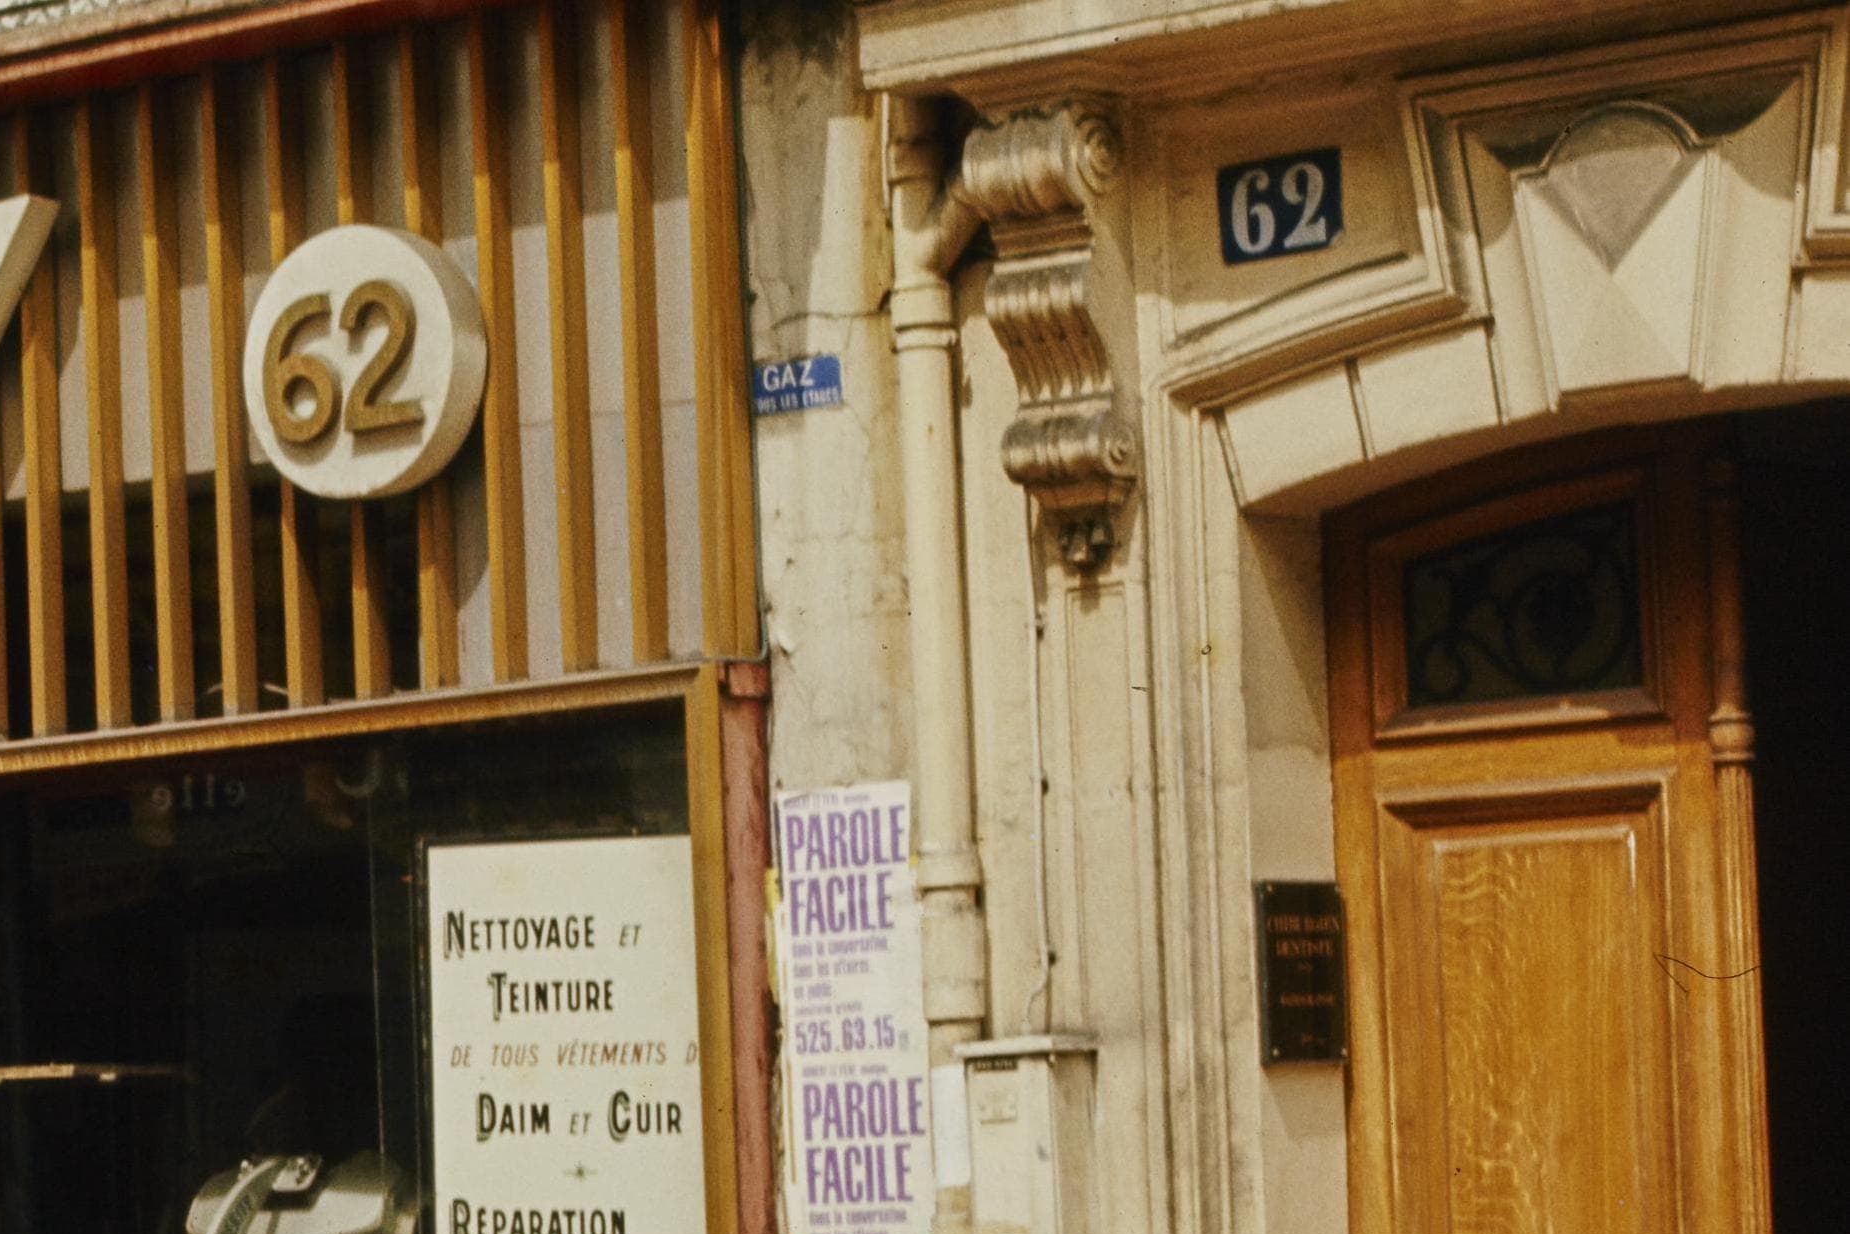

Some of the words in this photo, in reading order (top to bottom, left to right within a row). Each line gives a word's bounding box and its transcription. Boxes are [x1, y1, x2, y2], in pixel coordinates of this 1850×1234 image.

[1228, 161, 1328, 256] 62
[262, 280, 425, 444] 62
[763, 360, 814, 391] GAZ
[786, 805, 907, 873] PAROLE
[789, 871, 894, 937] FACILE
[444, 910, 595, 960] NETTOYAGE
[619, 924, 642, 947] ET
[487, 972, 613, 1021] TEINTURE
[450, 1045, 472, 1068] DE
[491, 1043, 539, 1067] TOUS
[795, 1014, 896, 1056] 525.63.15
[476, 1092, 551, 1143] DAIM
[569, 1112, 592, 1135] ET
[608, 1090, 682, 1143] CUIR
[802, 1077, 926, 1142] PAROLE
[806, 1143, 914, 1206] FACILE
